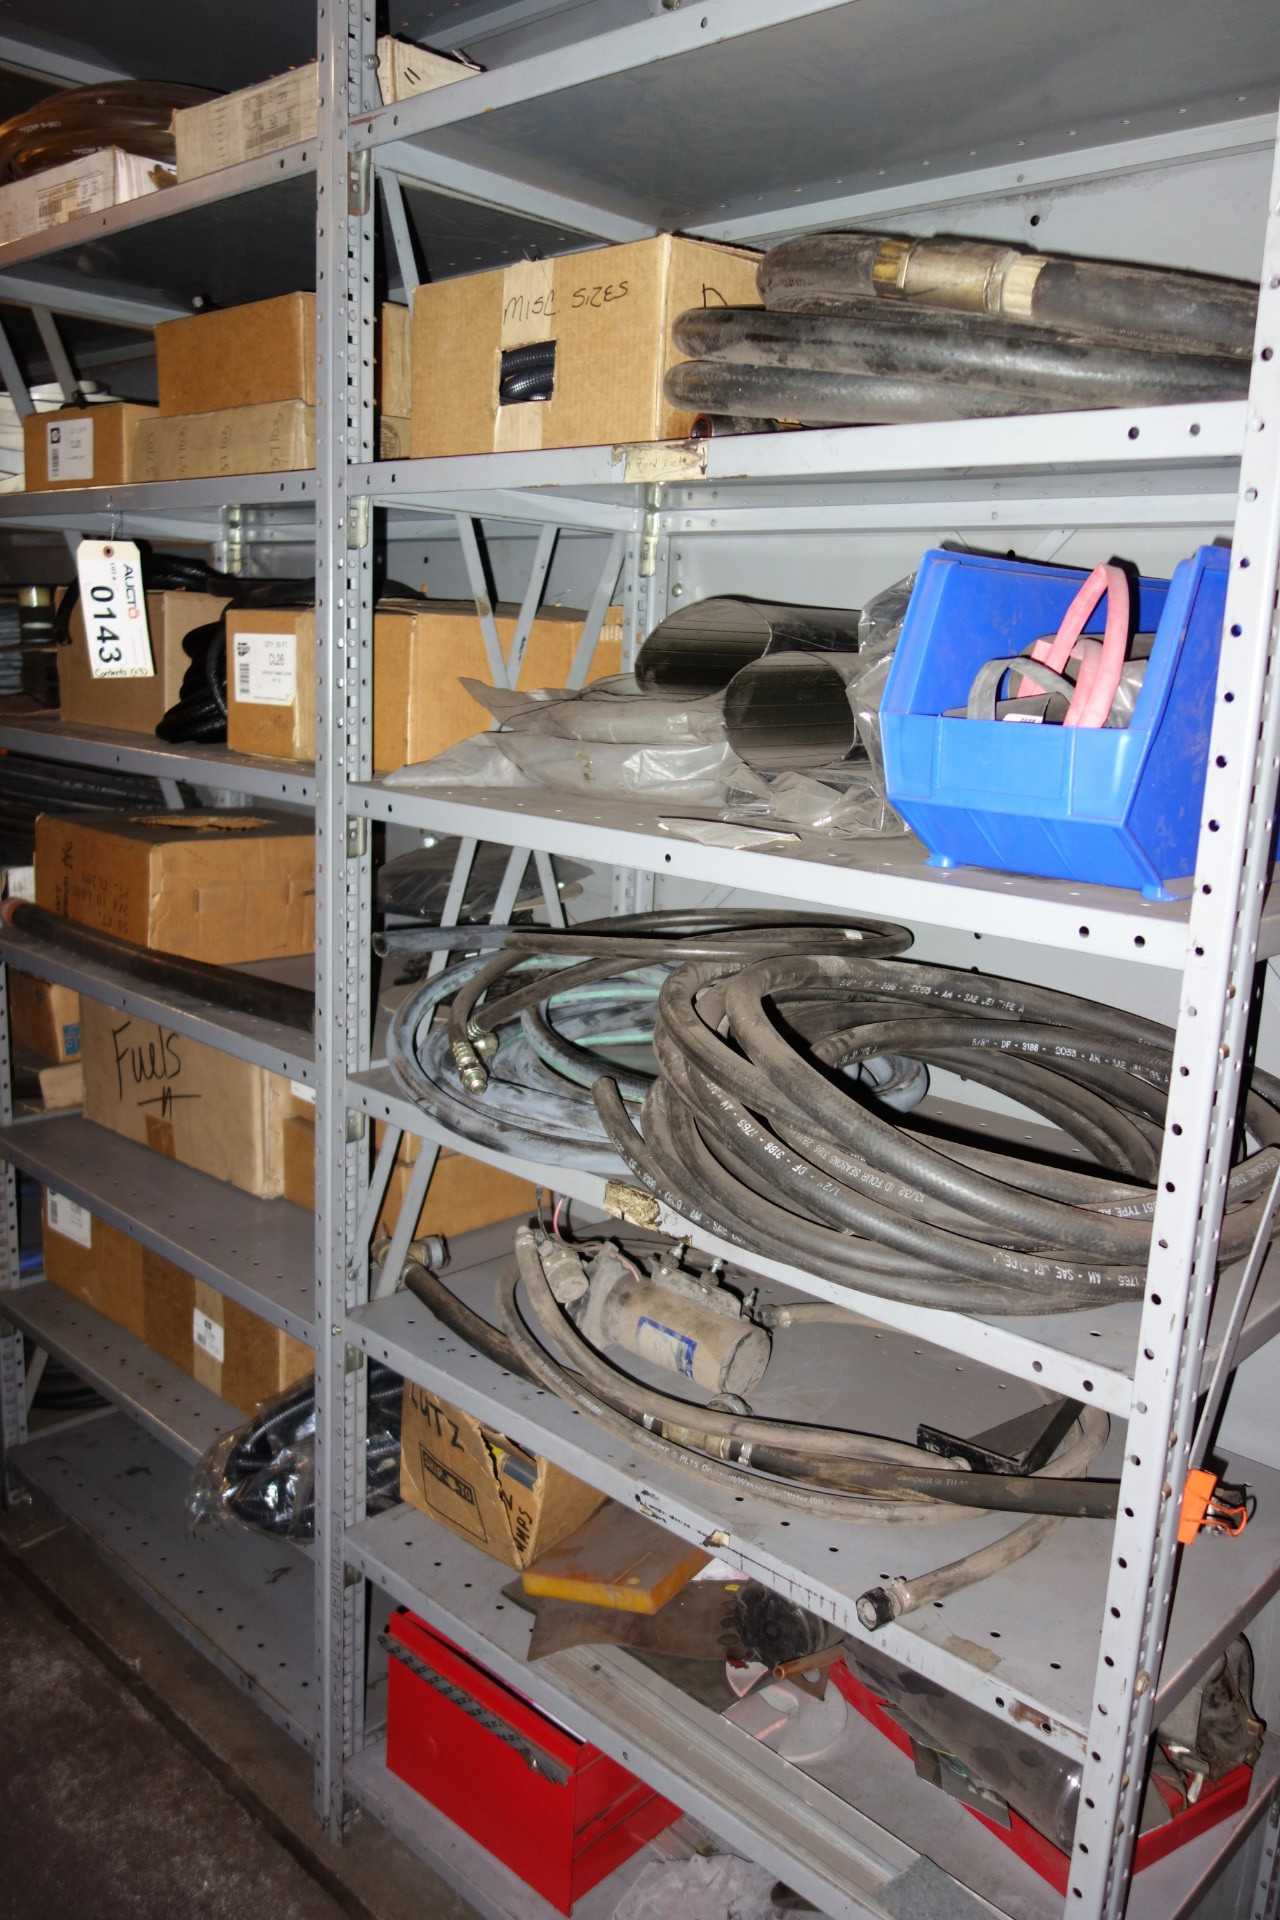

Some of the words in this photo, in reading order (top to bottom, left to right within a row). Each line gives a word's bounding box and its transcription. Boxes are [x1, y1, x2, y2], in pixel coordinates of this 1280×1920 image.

[503, 288, 557, 325] MISC
[571, 280, 629, 309] SIZES
[123, 563, 140, 619] AUCTO
[90, 586, 122, 663] 0143
[112, 1020, 182, 1101] Fuels
[763, 1142, 785, 1160] 3186
[860, 1173, 883, 1188] FOUR
[1115, 1204, 1140, 1218] TYPE
[1055, 1265, 1075, 1281] SAE
